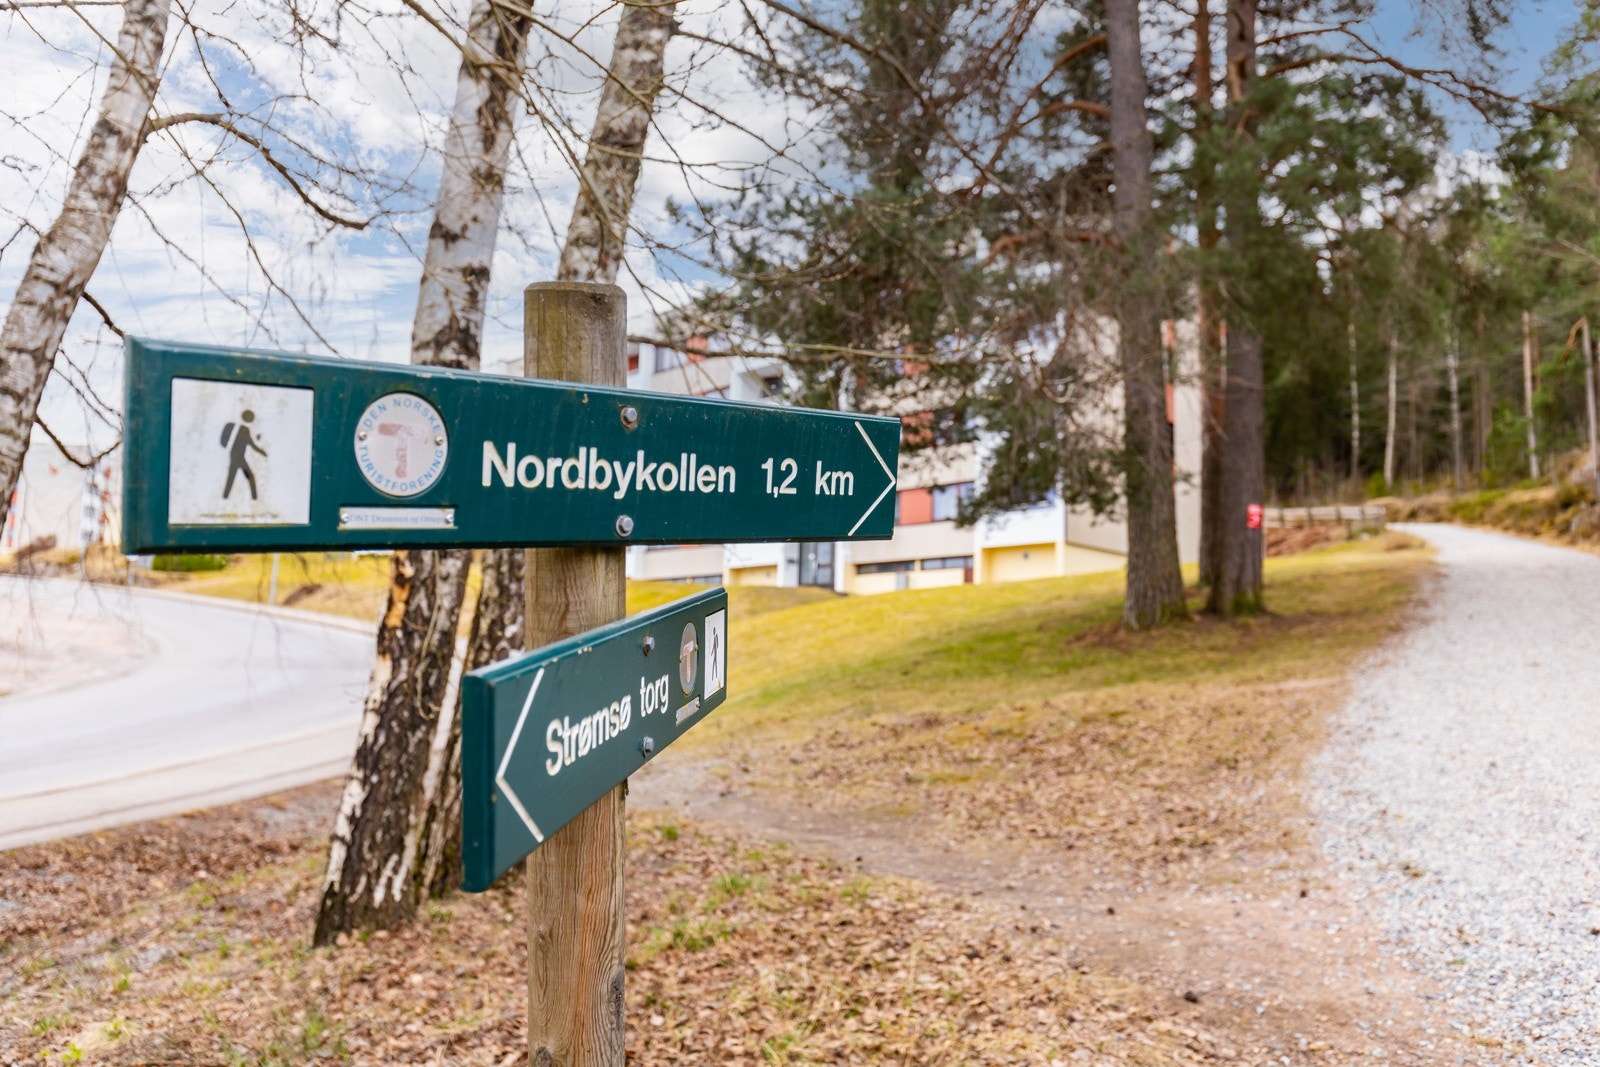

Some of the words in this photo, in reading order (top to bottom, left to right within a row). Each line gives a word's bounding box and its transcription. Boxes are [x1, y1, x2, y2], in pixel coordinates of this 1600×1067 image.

[363, 403, 387, 429] DEN
[393, 398, 441, 433] NORSKE
[359, 446, 444, 491] TURISTFORENING
[481, 440, 736, 500] Nordbykollen
[761, 456, 798, 498] 1,2
[815, 460, 854, 496] km
[545, 694, 632, 777] Strømsø
[639, 674, 669, 718] torg
